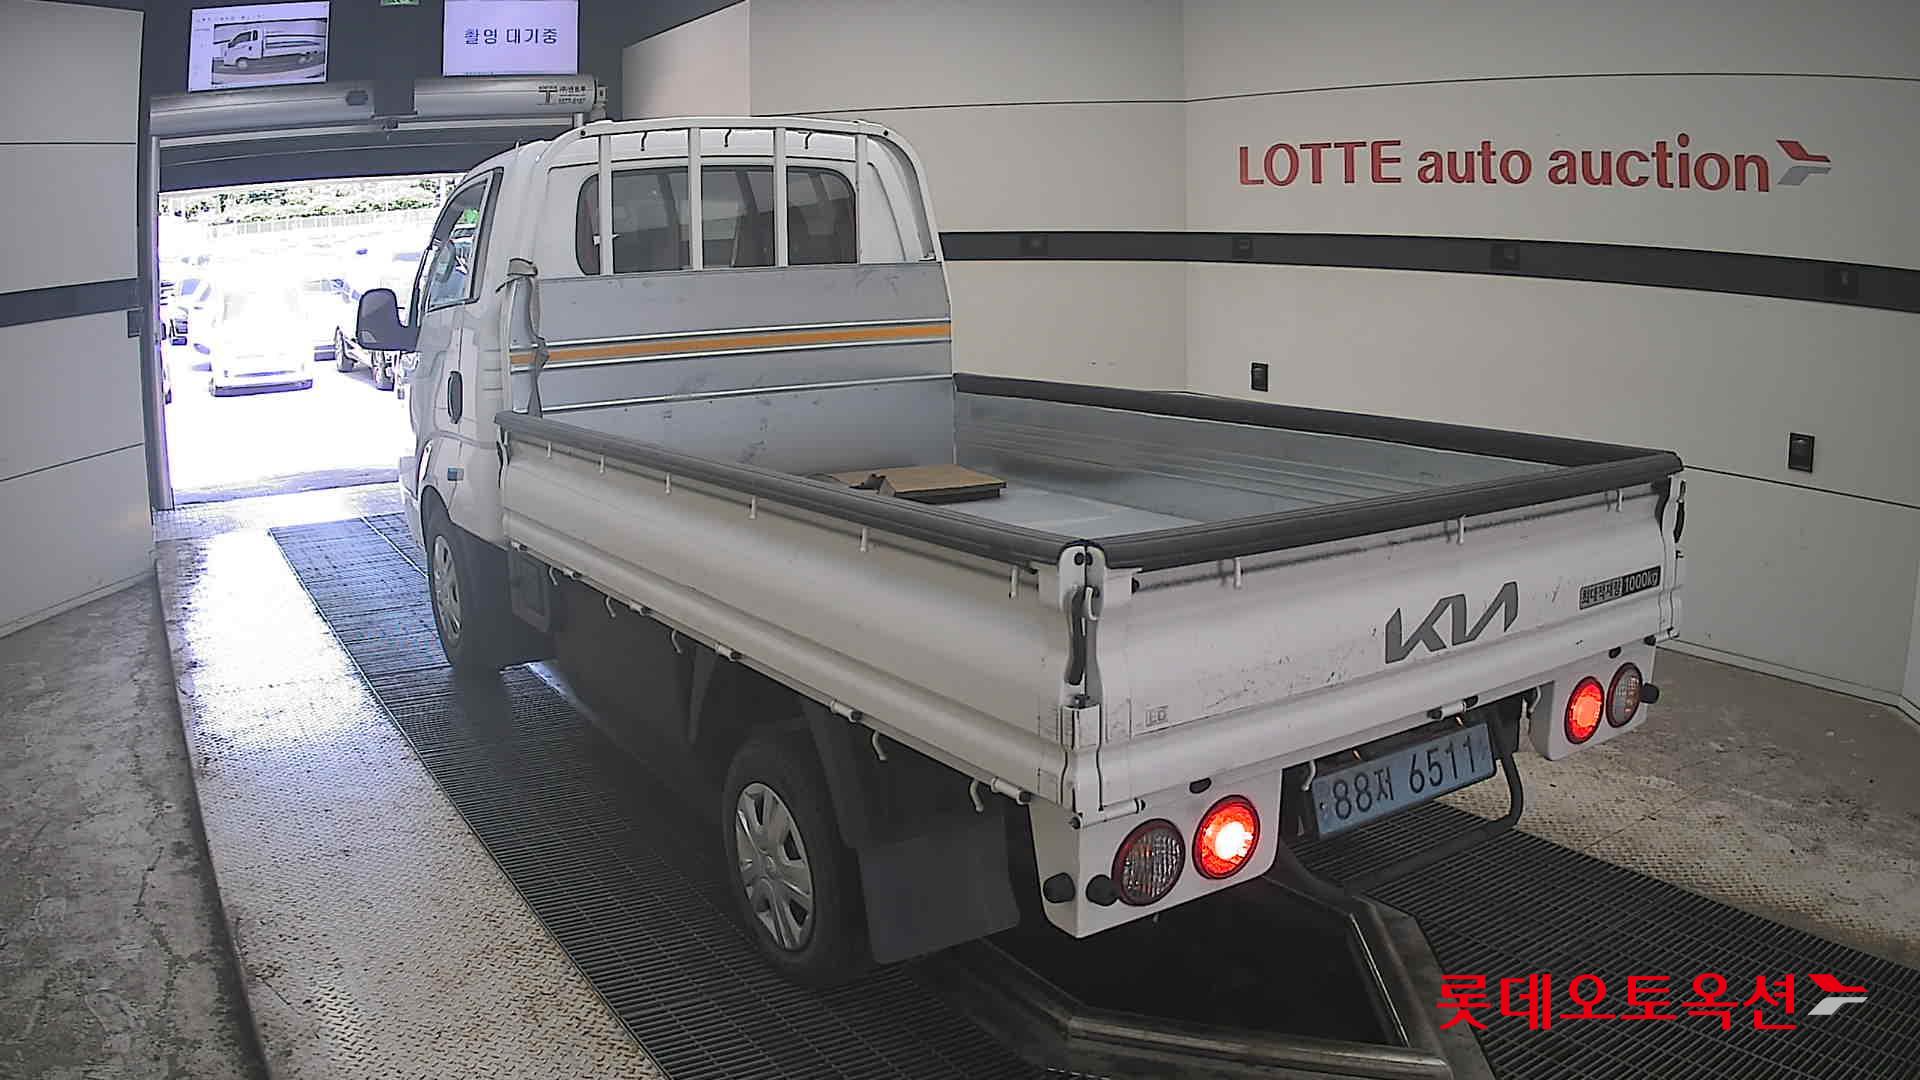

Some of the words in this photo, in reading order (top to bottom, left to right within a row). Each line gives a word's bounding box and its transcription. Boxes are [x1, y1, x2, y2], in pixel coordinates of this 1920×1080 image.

[464, 28, 498, 45] 촬영
[506, 28, 558, 45] 대기중
[1239, 140, 1402, 187] LOTTE
[1417, 140, 1532, 185] auto
[1548, 132, 1769, 192] auction
[1624, 571, 1659, 593] 1000kg
[1332, 766, 1394, 820] 88저
[1409, 735, 1475, 794] 6511
